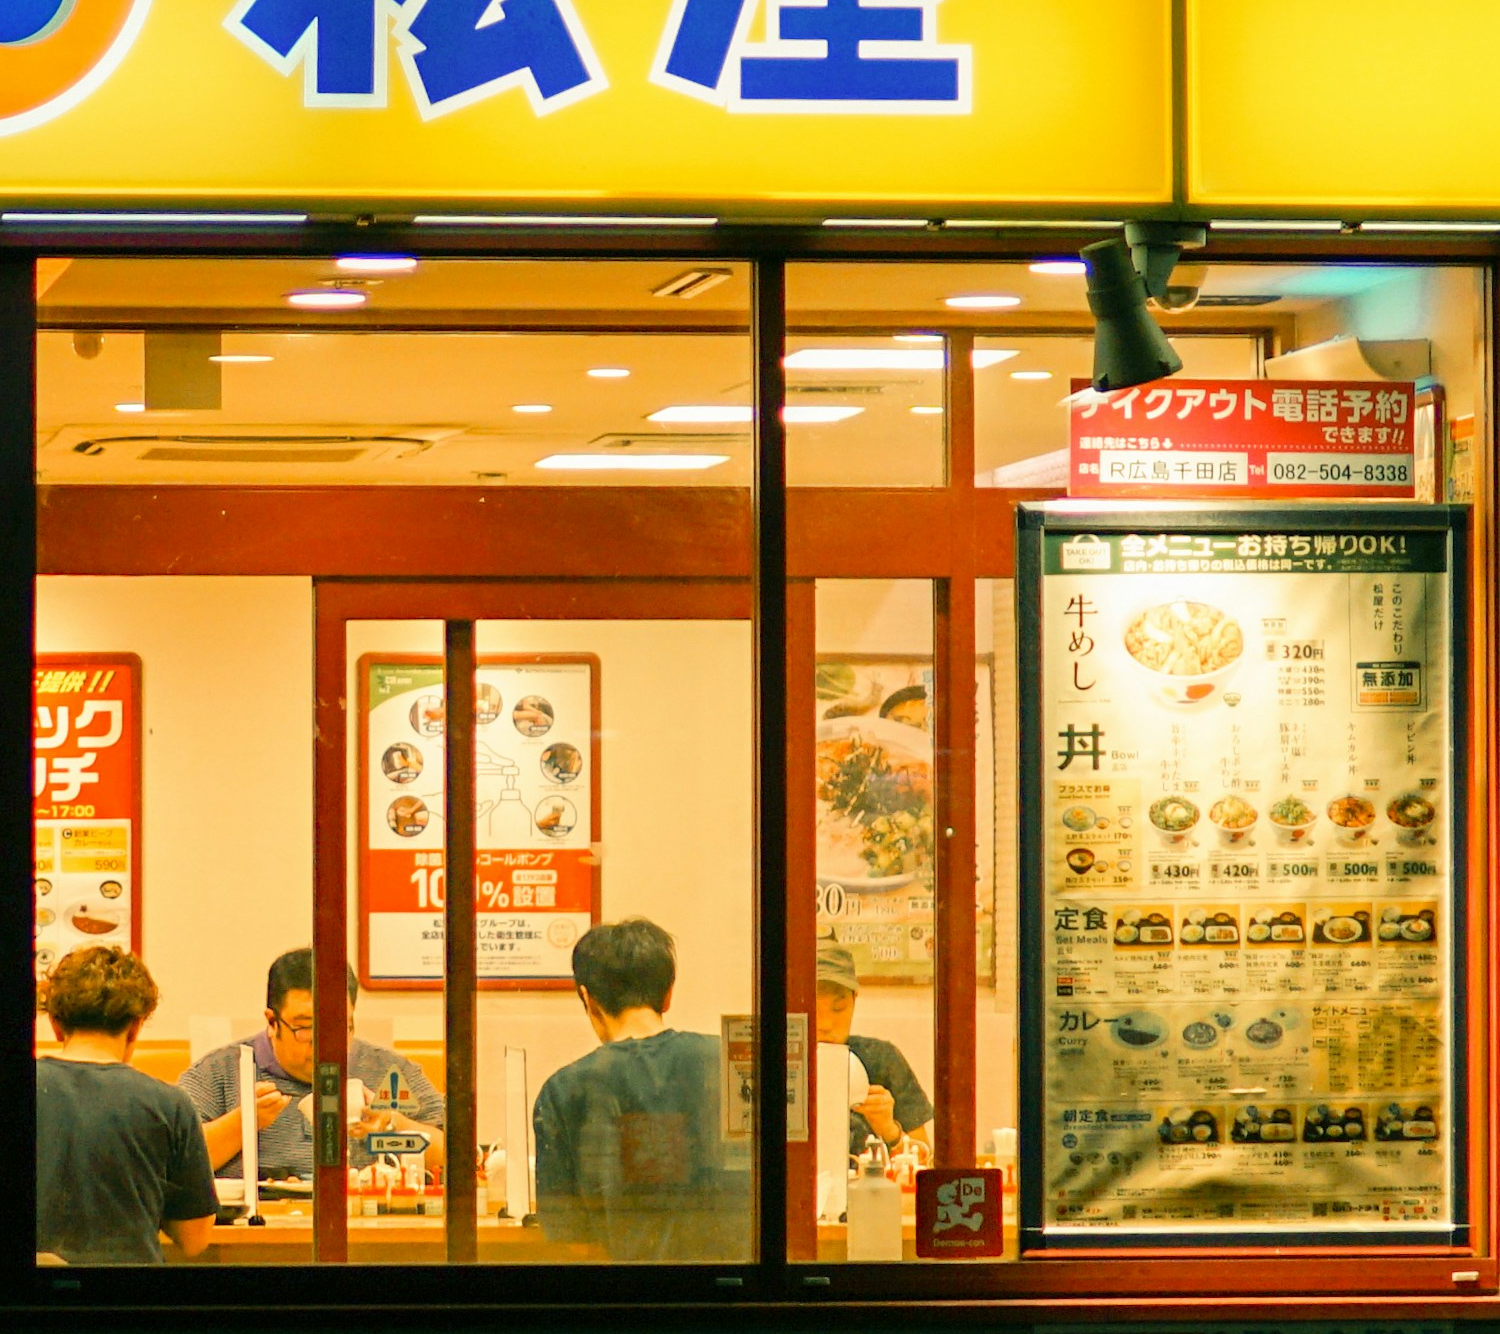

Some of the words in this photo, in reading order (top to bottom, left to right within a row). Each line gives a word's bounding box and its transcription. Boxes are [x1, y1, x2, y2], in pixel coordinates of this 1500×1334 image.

[1110, 459, 1238, 483] R広島千田店
[1249, 465, 1265, 475] Tel
[1273, 464, 1409, 483] 082-504-8338
[1121, 534, 1407, 558] 全メニューお持ち帰りOK!
[1372, 583, 1385, 632] 松屋だけ
[1391, 583, 1404, 656] このこだわり
[1063, 593, 1099, 691] 牛めし
[37, 670, 115, 694] 提供!!
[1362, 671, 1414, 687] 無添加
[1057, 723, 1107, 771] 丼
[1111, 750, 1140, 760] Bowl
[35, 752, 99, 803] チ
[1054, 906, 1109, 932] 定食
[1059, 1011, 1119, 1032] カレー
